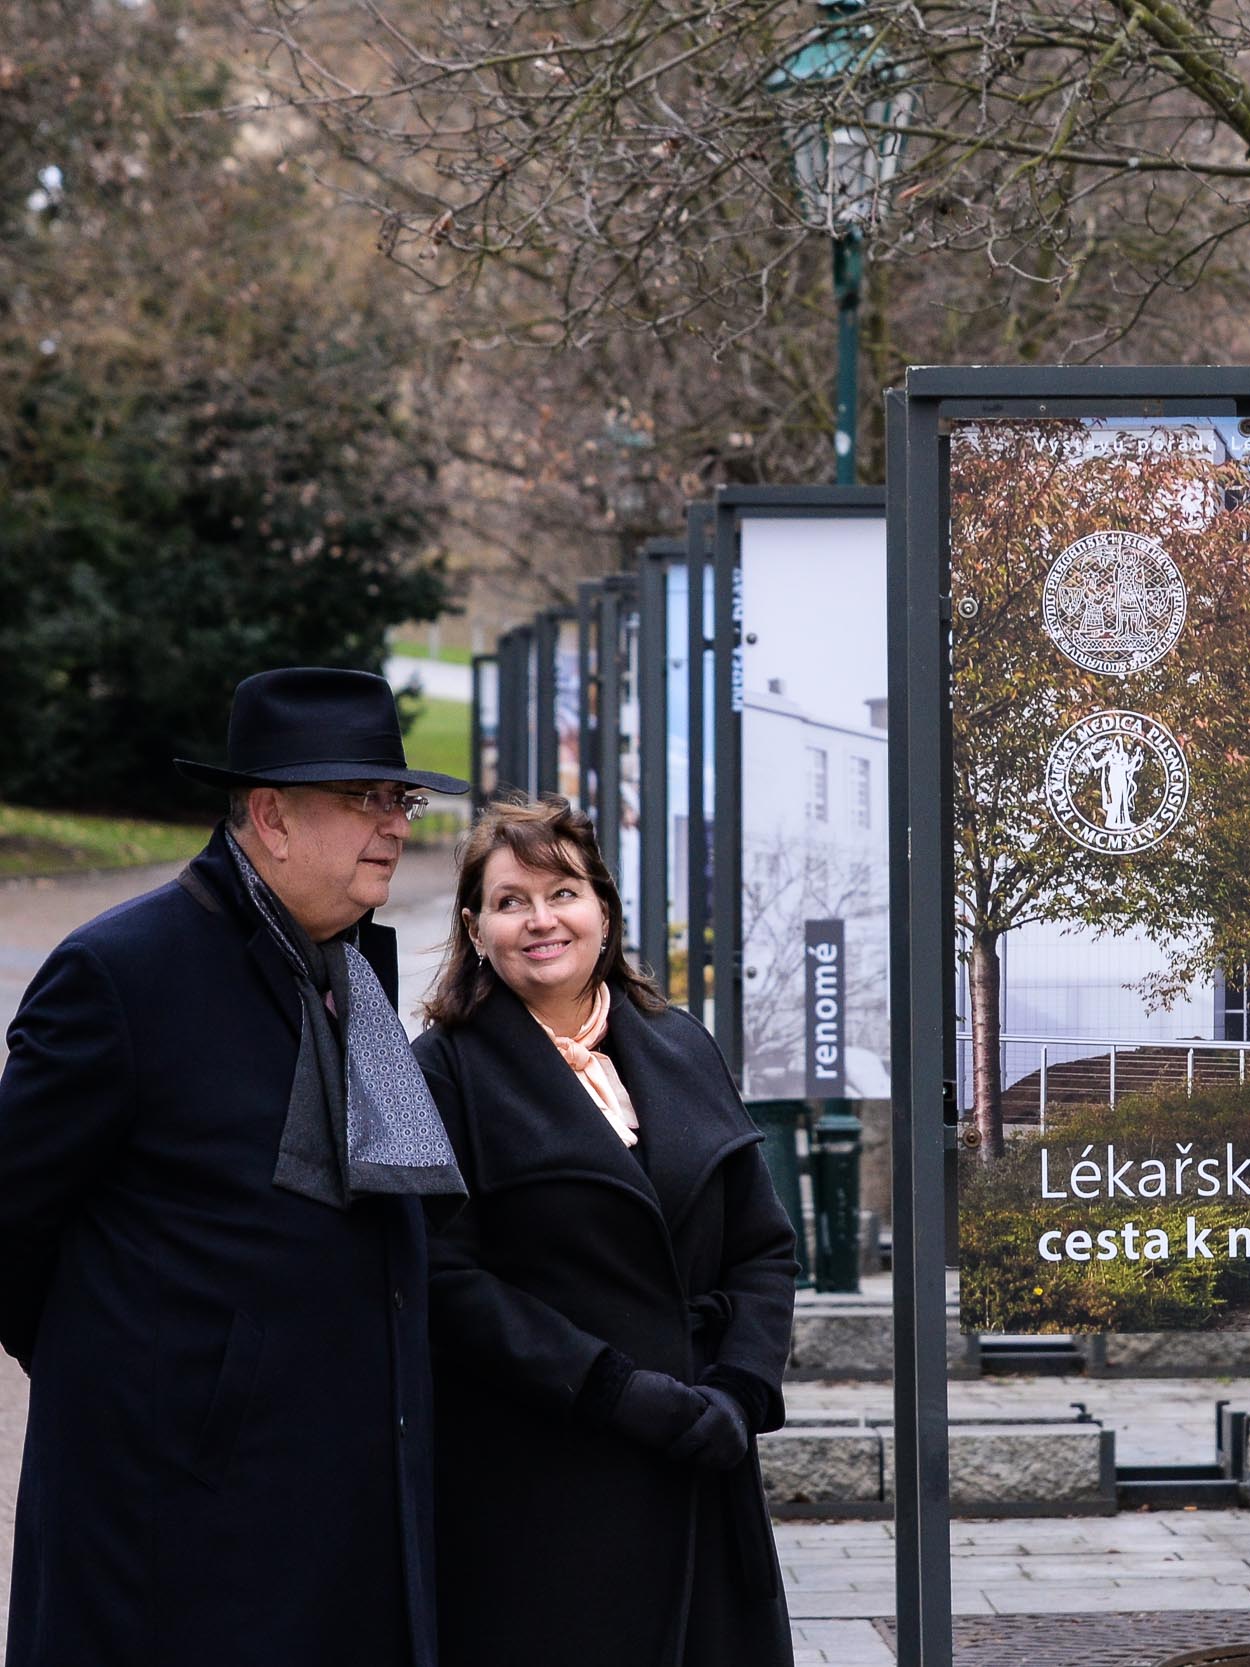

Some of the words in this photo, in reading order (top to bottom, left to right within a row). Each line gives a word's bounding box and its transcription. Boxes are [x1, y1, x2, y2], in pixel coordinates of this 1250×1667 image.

[1076, 716, 1144, 742] MEDICA
[1079, 824, 1156, 849] MCMXLV
[808, 942, 838, 1079] renomé
[1038, 1219, 1169, 1261] cesta
[1186, 1216, 1214, 1259] k
